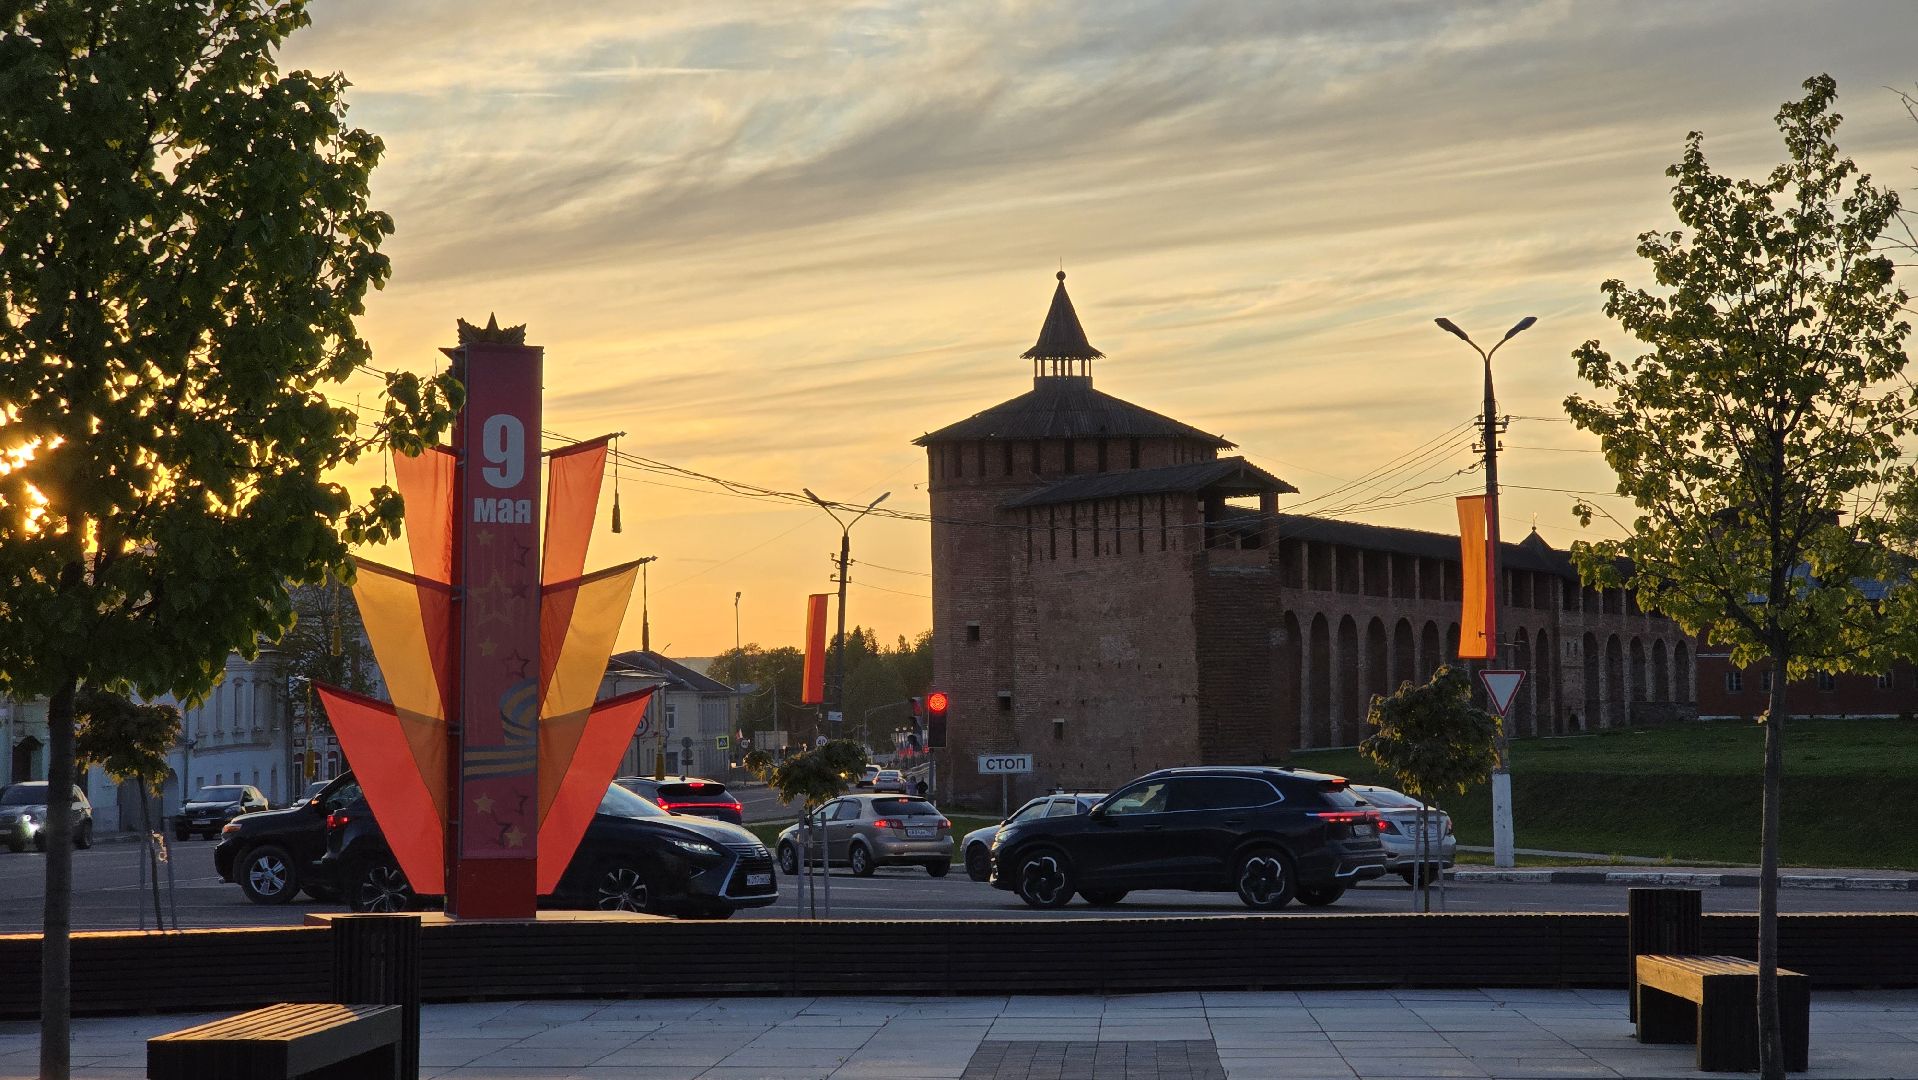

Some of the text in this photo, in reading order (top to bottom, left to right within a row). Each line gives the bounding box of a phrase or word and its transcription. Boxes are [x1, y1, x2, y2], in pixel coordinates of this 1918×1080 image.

[482, 413, 525, 489] 9
[473, 497, 532, 524] мая
[986, 758, 1026, 770] СТОП
